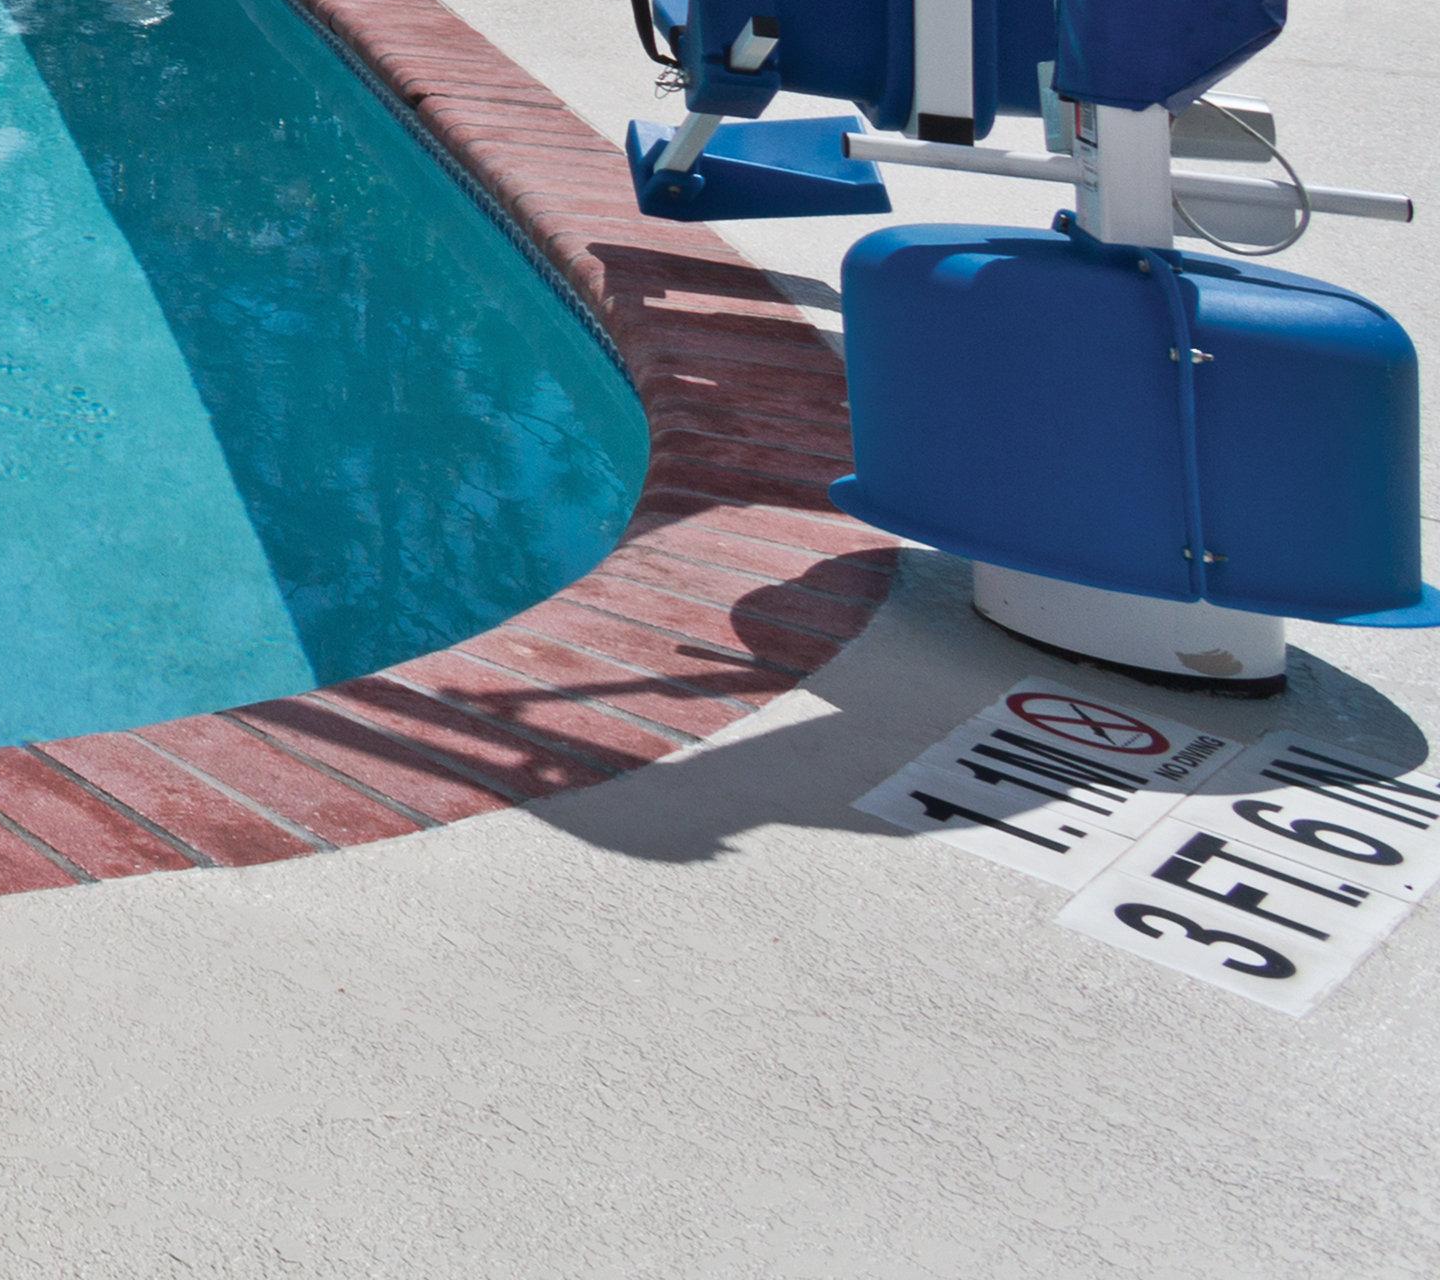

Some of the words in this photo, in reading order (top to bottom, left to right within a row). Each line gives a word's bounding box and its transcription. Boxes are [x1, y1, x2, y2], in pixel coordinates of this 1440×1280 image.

[1153, 762, 1190, 782] NO
[1171, 735, 1226, 768] DIVING
[909, 728, 1149, 854] 1.1M
[1231, 798, 1404, 866] 6
[1150, 831, 1370, 942] FT.
[1113, 902, 1297, 981] 3
